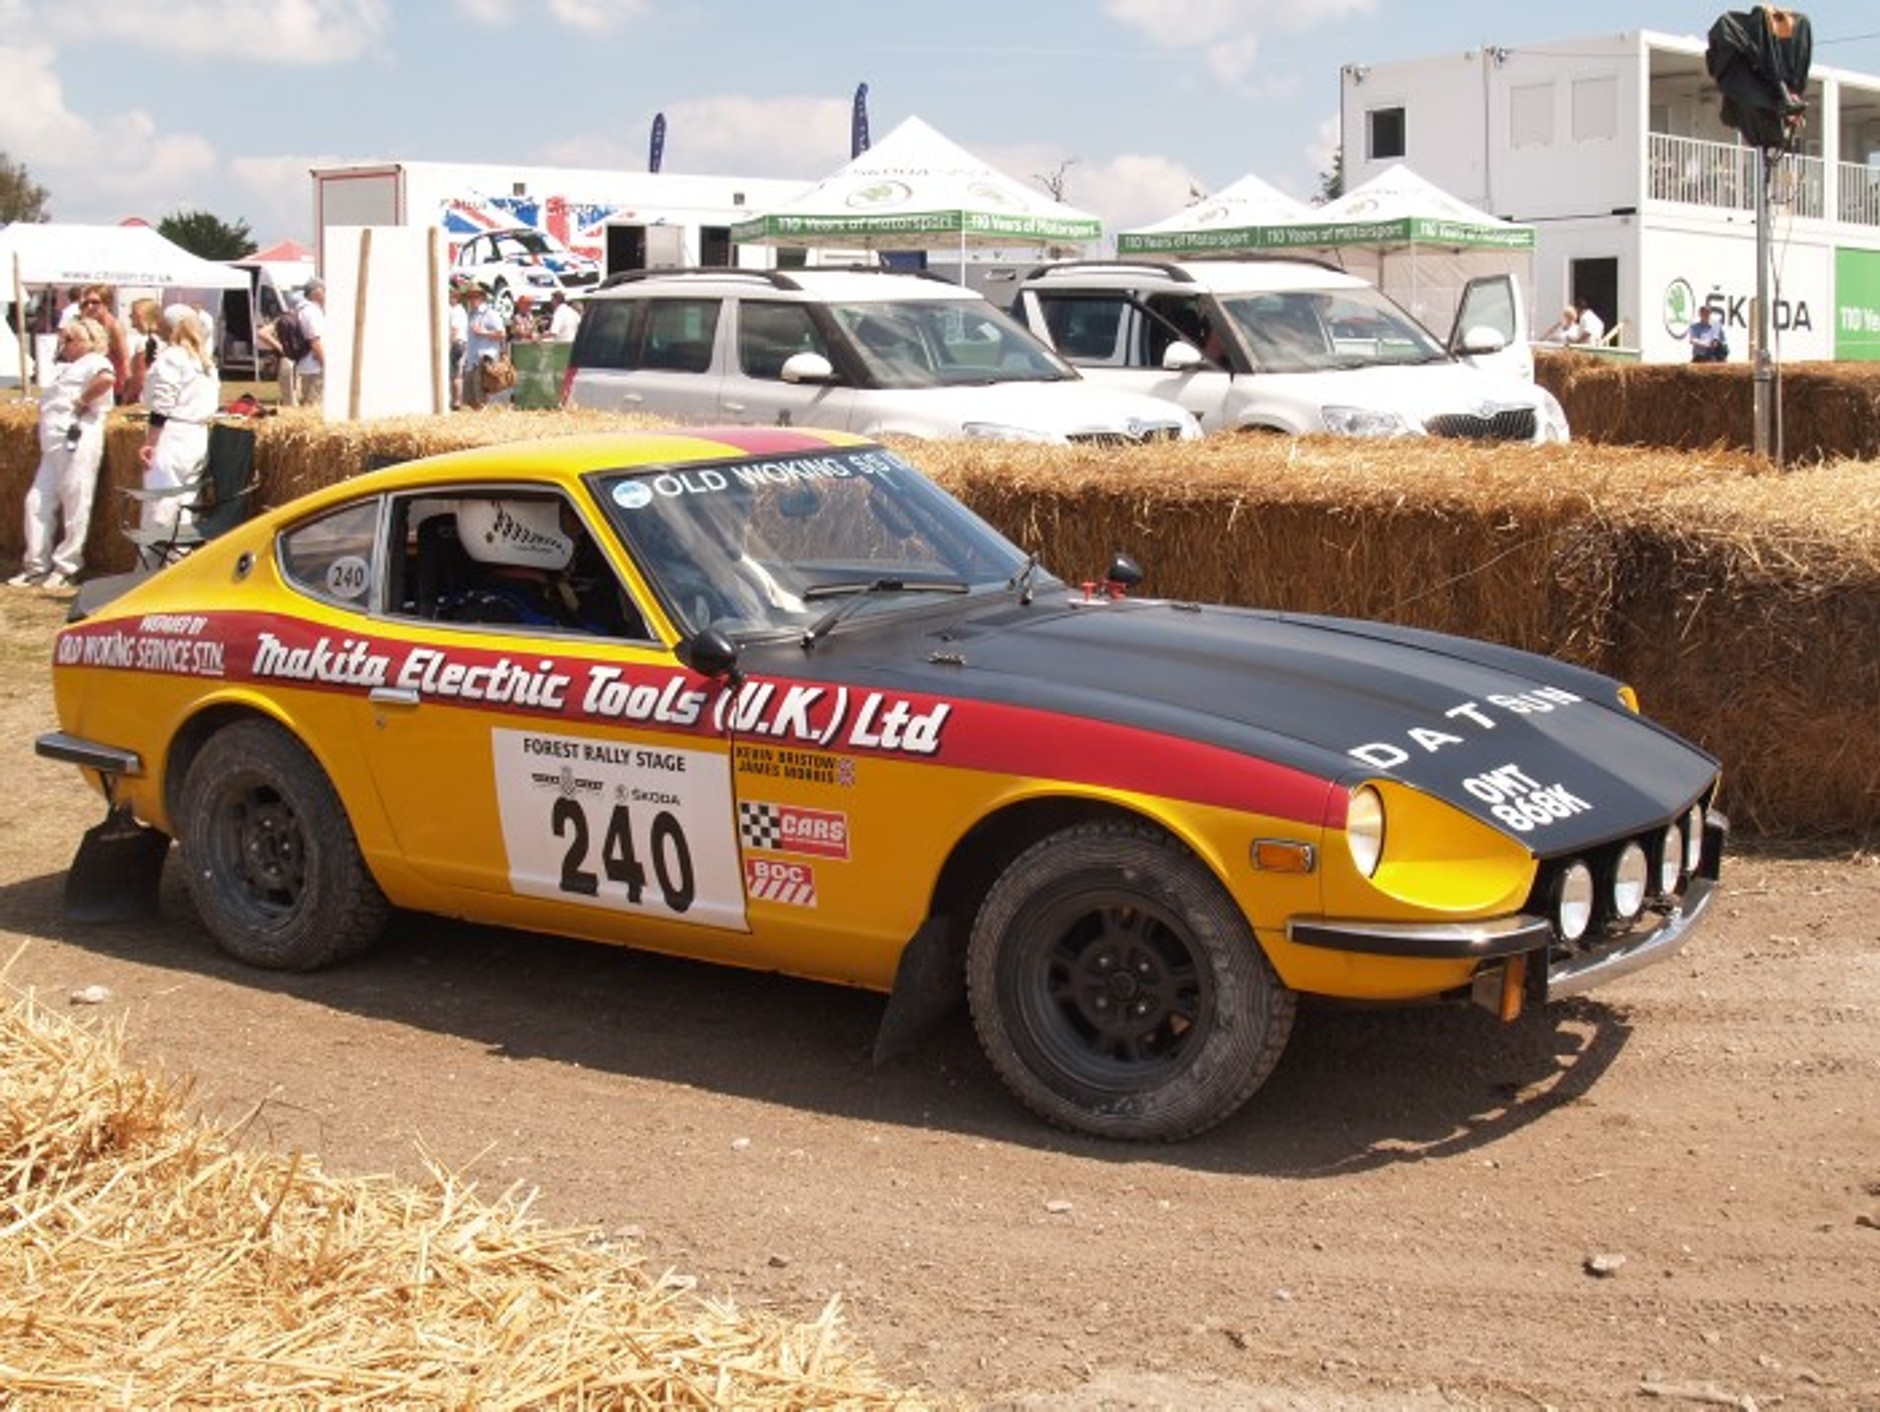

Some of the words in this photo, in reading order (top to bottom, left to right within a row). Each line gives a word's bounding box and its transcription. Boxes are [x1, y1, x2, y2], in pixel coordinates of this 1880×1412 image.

[1705, 285, 1812, 331] ŠKDA
[1840, 305, 1862, 332] 110
[653, 471, 728, 497] OLD
[730, 456, 850, 488] WOKING
[333, 565, 364, 588] 240
[59, 633, 84, 665] OLD
[137, 635, 191, 672] SERVICE
[251, 632, 389, 686] Makita
[397, 647, 570, 709] Electric
[582, 664, 707, 725] Tools
[849, 692, 951, 753] Ltd
[1347, 685, 1584, 770] DATSUN
[523, 737, 579, 760] FOREST
[583, 743, 632, 765] RALLY
[636, 750, 687, 772] STAGE
[735, 746, 773, 762] KEVIN
[778, 750, 837, 770] BRISTOW
[738, 760, 780, 778] JAMES
[784, 766, 835, 785] MORRIS
[781, 813, 845, 841] CARS
[551, 796, 696, 914] 240
